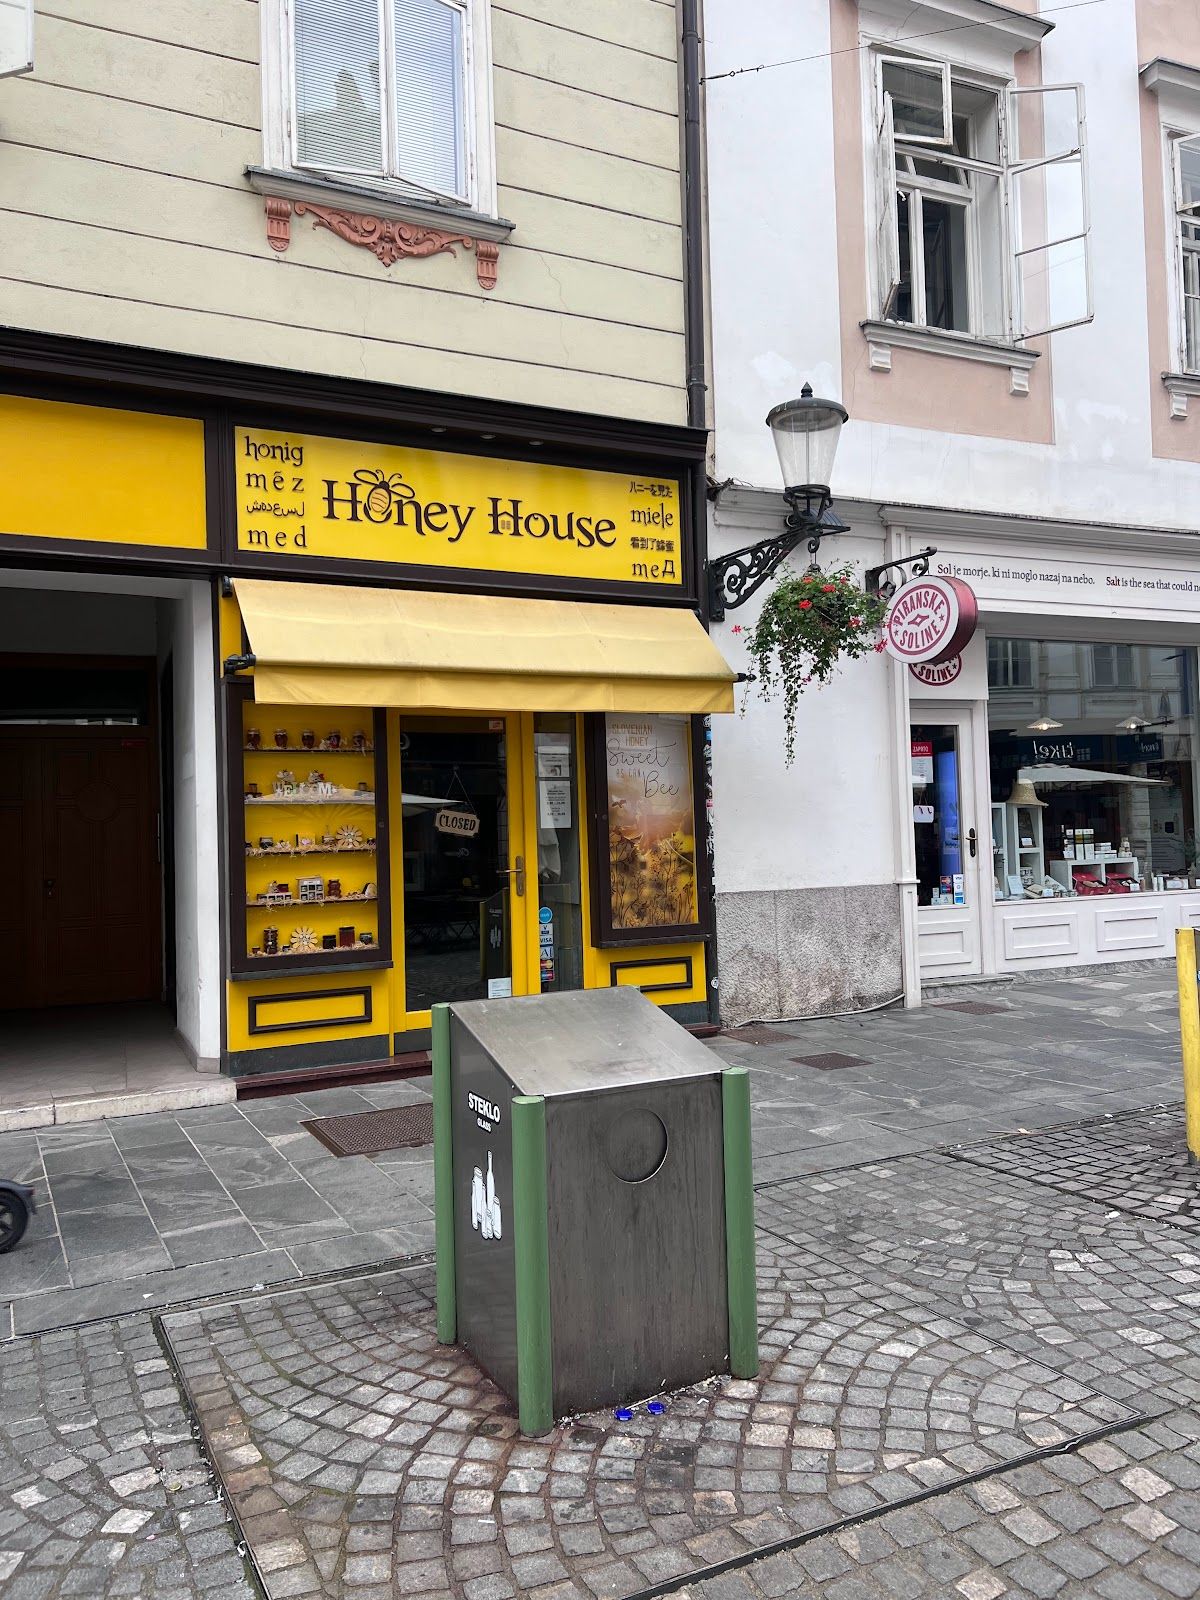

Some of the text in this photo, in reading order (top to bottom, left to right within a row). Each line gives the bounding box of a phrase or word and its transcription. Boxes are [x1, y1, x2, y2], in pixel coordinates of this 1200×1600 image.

[244, 436, 304, 466] honig
[321, 470, 617, 548] Honey House
[630, 503, 674, 529] miele
[247, 525, 308, 548] med
[937, 563, 952, 575] Sol
[953, 565, 962, 578] je
[992, 567, 1001, 578] ki
[1002, 569, 1011, 579] ni
[1012, 570, 1038, 582] moglo
[1039, 573, 1061, 584] nazaj
[1062, 574, 1072, 583] na
[1073, 574, 1095, 585] nebo.
[1106, 576, 1121, 587] Salt
[1121, 577, 1128, 587] is
[1129, 577, 1142, 588] the
[1143, 580, 1155, 589] sea
[1156, 579, 1171, 590] that
[1171, 581, 1193, 592] could
[893, 590, 945, 627] PIRANSKE
[899, 619, 941, 649] SOLINE
[918, 664, 954, 682] SOLINE
[606, 738, 677, 768] Sweet
[642, 770, 680, 799] Bee
[439, 814, 477, 832] CLOSED
[468, 1092, 501, 1123] STEKLO
